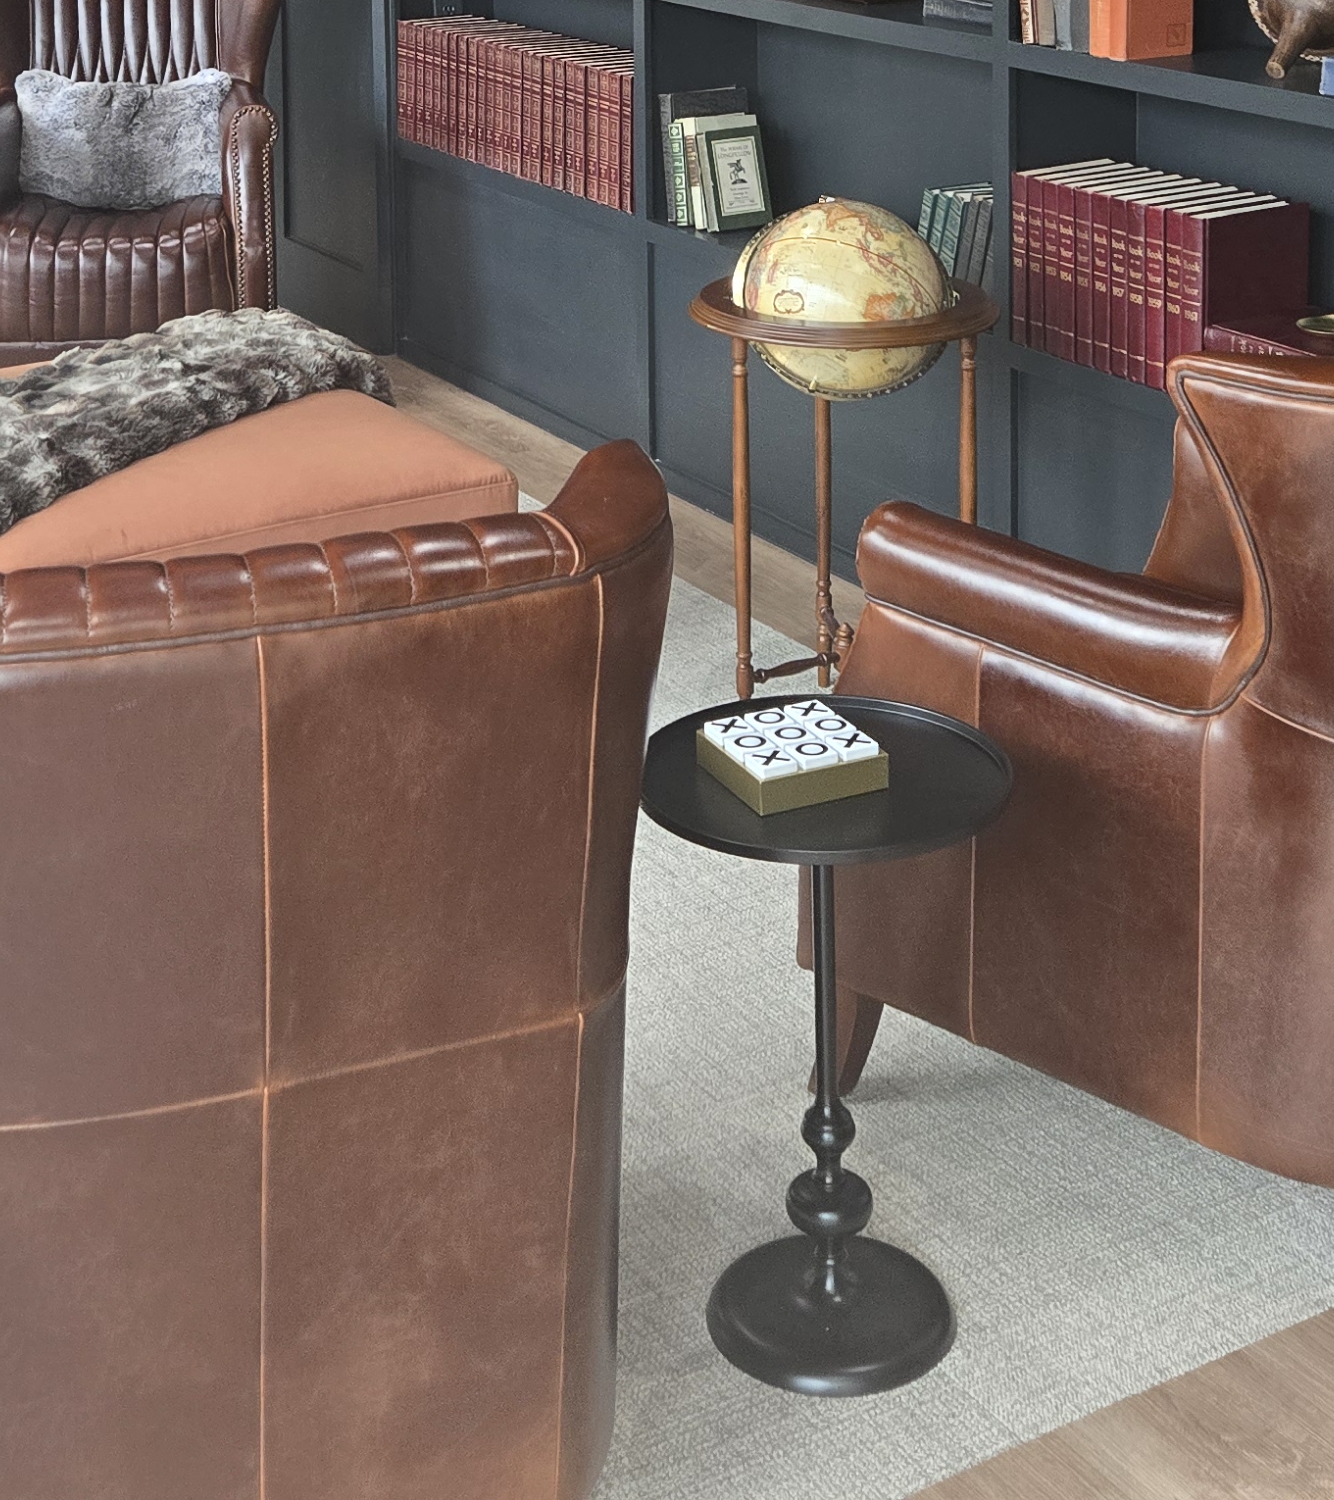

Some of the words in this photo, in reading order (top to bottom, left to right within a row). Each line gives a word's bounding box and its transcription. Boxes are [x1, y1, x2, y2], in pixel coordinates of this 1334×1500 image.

[712, 718, 748, 734] X
[753, 711, 785, 724] O
[791, 702, 828, 716] X
[734, 735, 767, 749] O
[774, 726, 807, 740] O
[814, 718, 847, 731] O
[752, 750, 791, 766] X
[795, 742, 828, 756] O
[832, 733, 872, 748] X
